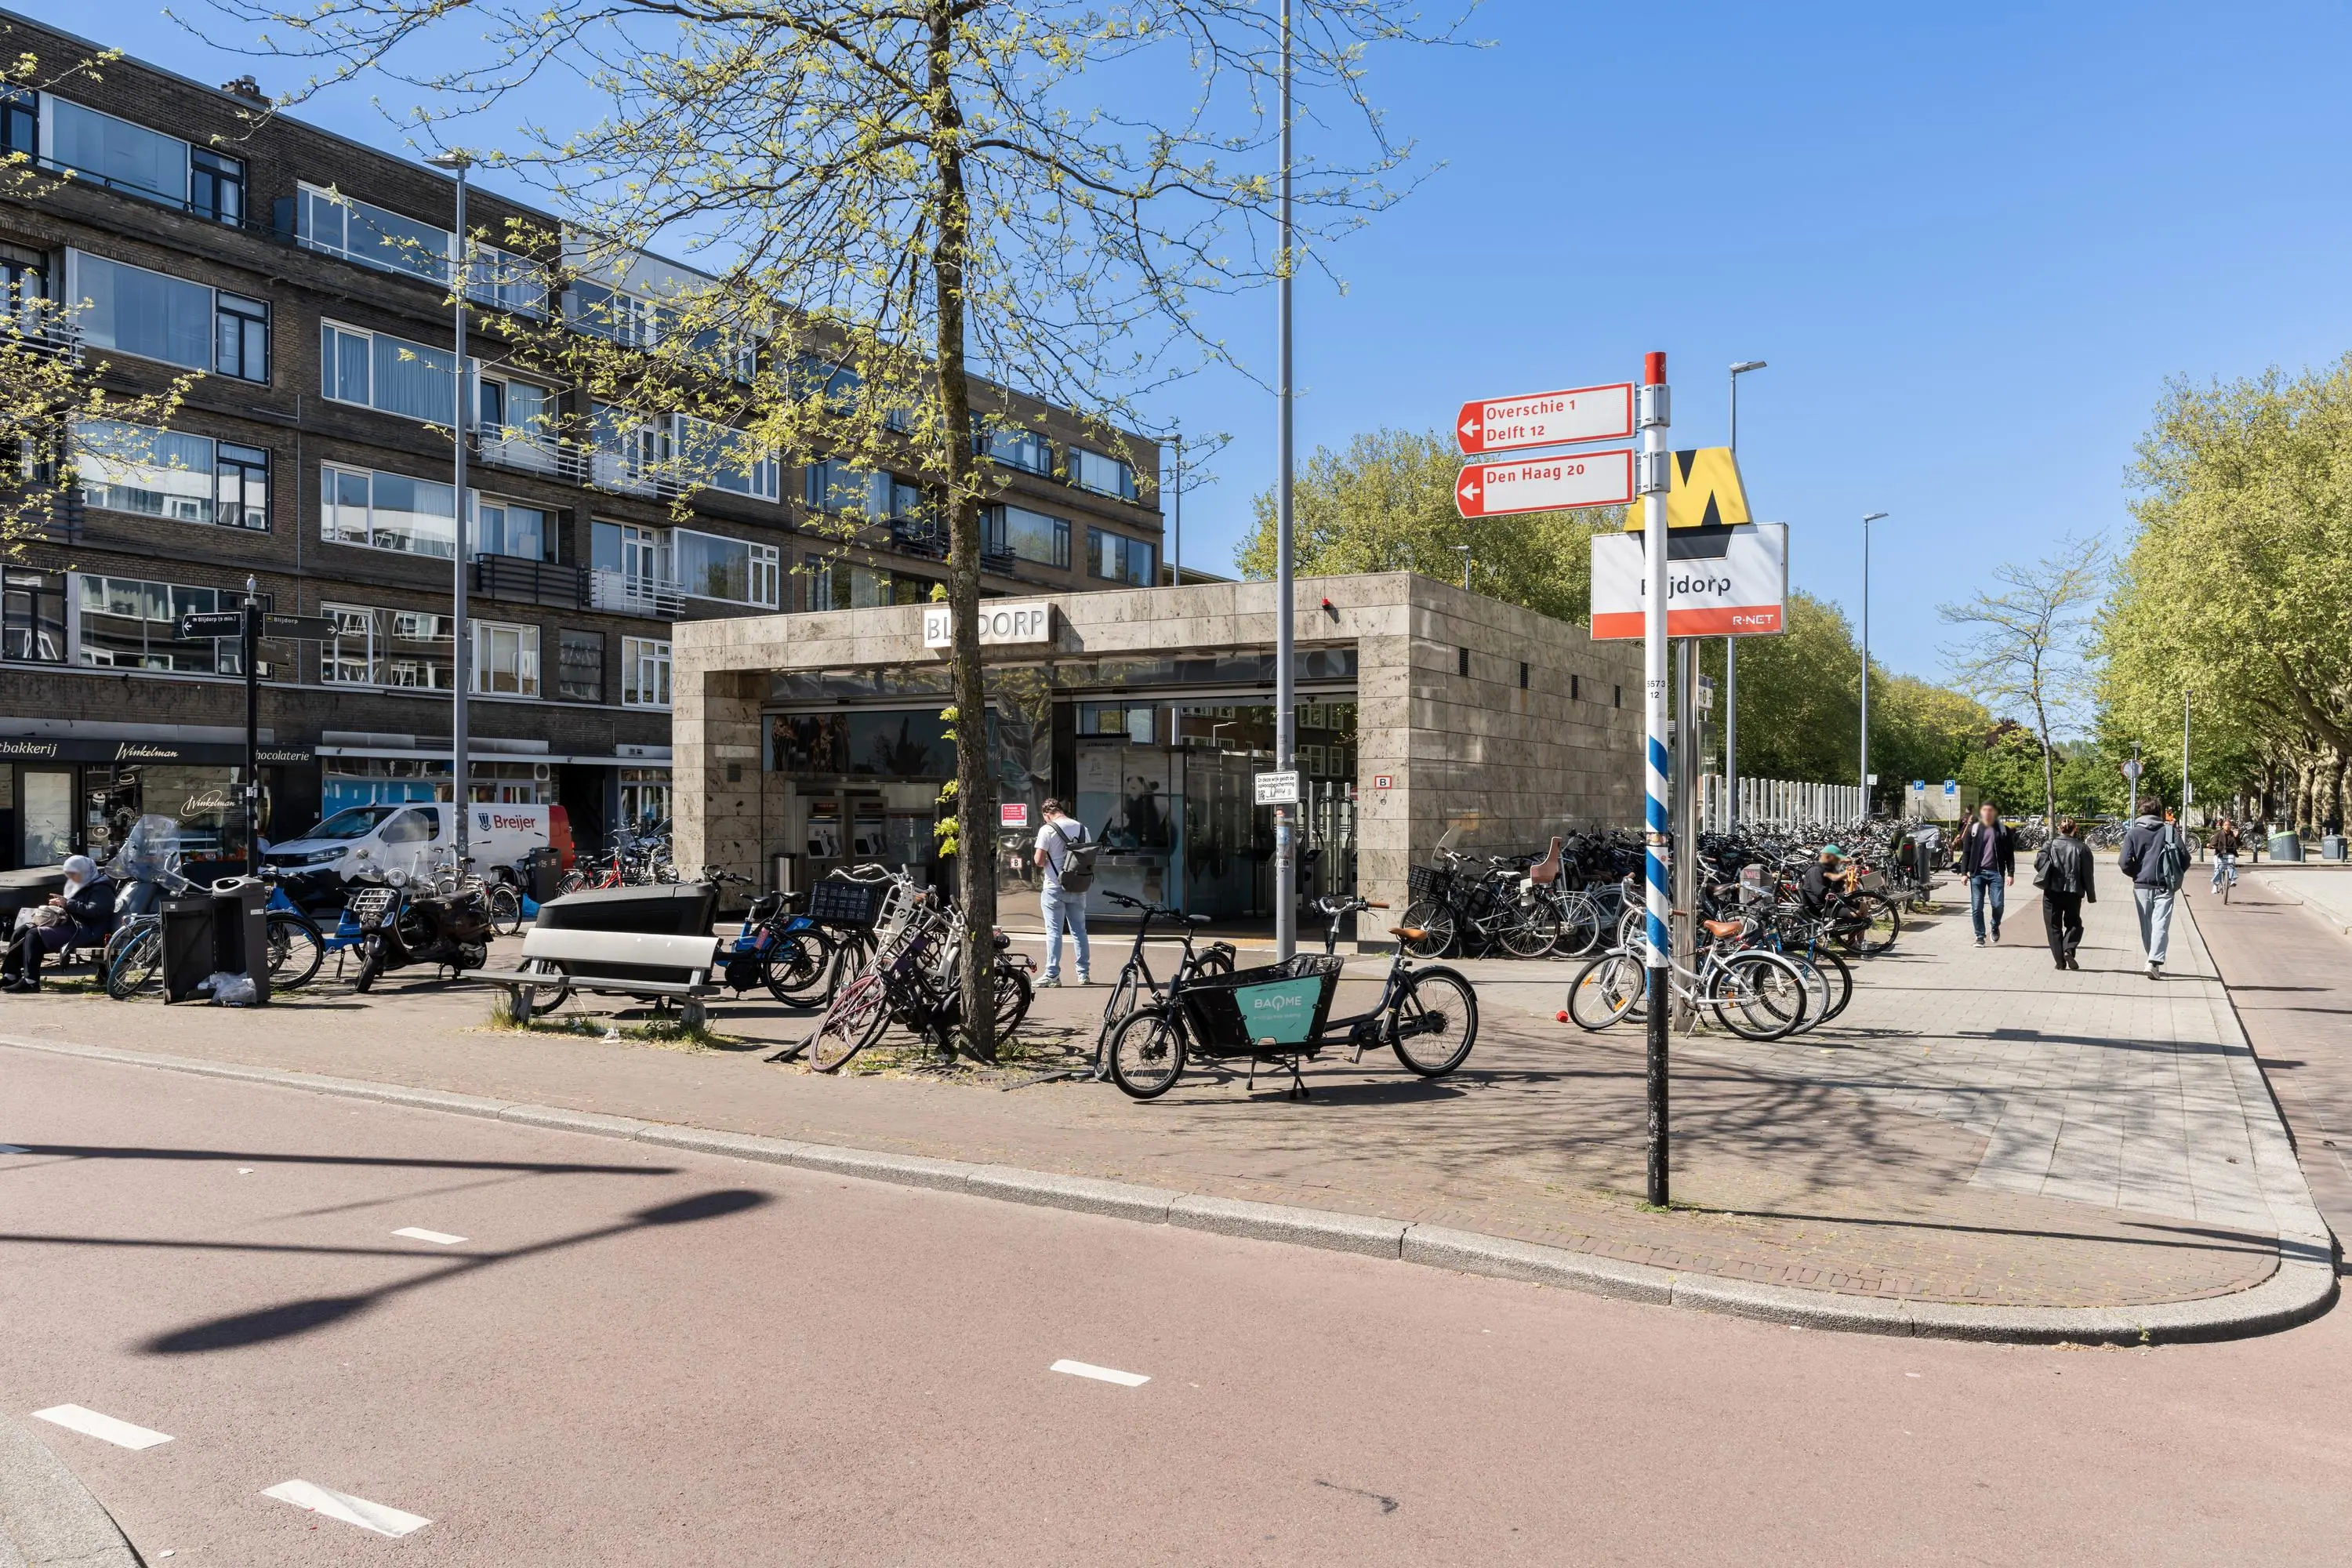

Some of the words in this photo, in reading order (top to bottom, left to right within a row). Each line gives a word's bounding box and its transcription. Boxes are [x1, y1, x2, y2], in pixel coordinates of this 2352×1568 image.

[1486, 400, 1564, 419] Overschie
[1569, 400, 1575, 410] 1
[1486, 426, 1525, 441] Delft
[1530, 426, 1544, 436] 12
[1486, 471, 1515, 484] Den
[1522, 467, 1561, 481] Haag
[1567, 464, 1584, 476] 20
[1641, 575, 1731, 599] jdorp
[274, 616, 299, 625] Blijdorp
[928, 611, 1044, 641] BLDORP
[114, 742, 179, 760] Winkelman
[256, 749, 310, 761] hocolaterie
[186, 794, 237, 811] Winkelman
[493, 815, 536, 832] Breijer
[1254, 995, 1302, 1011] BAQME
